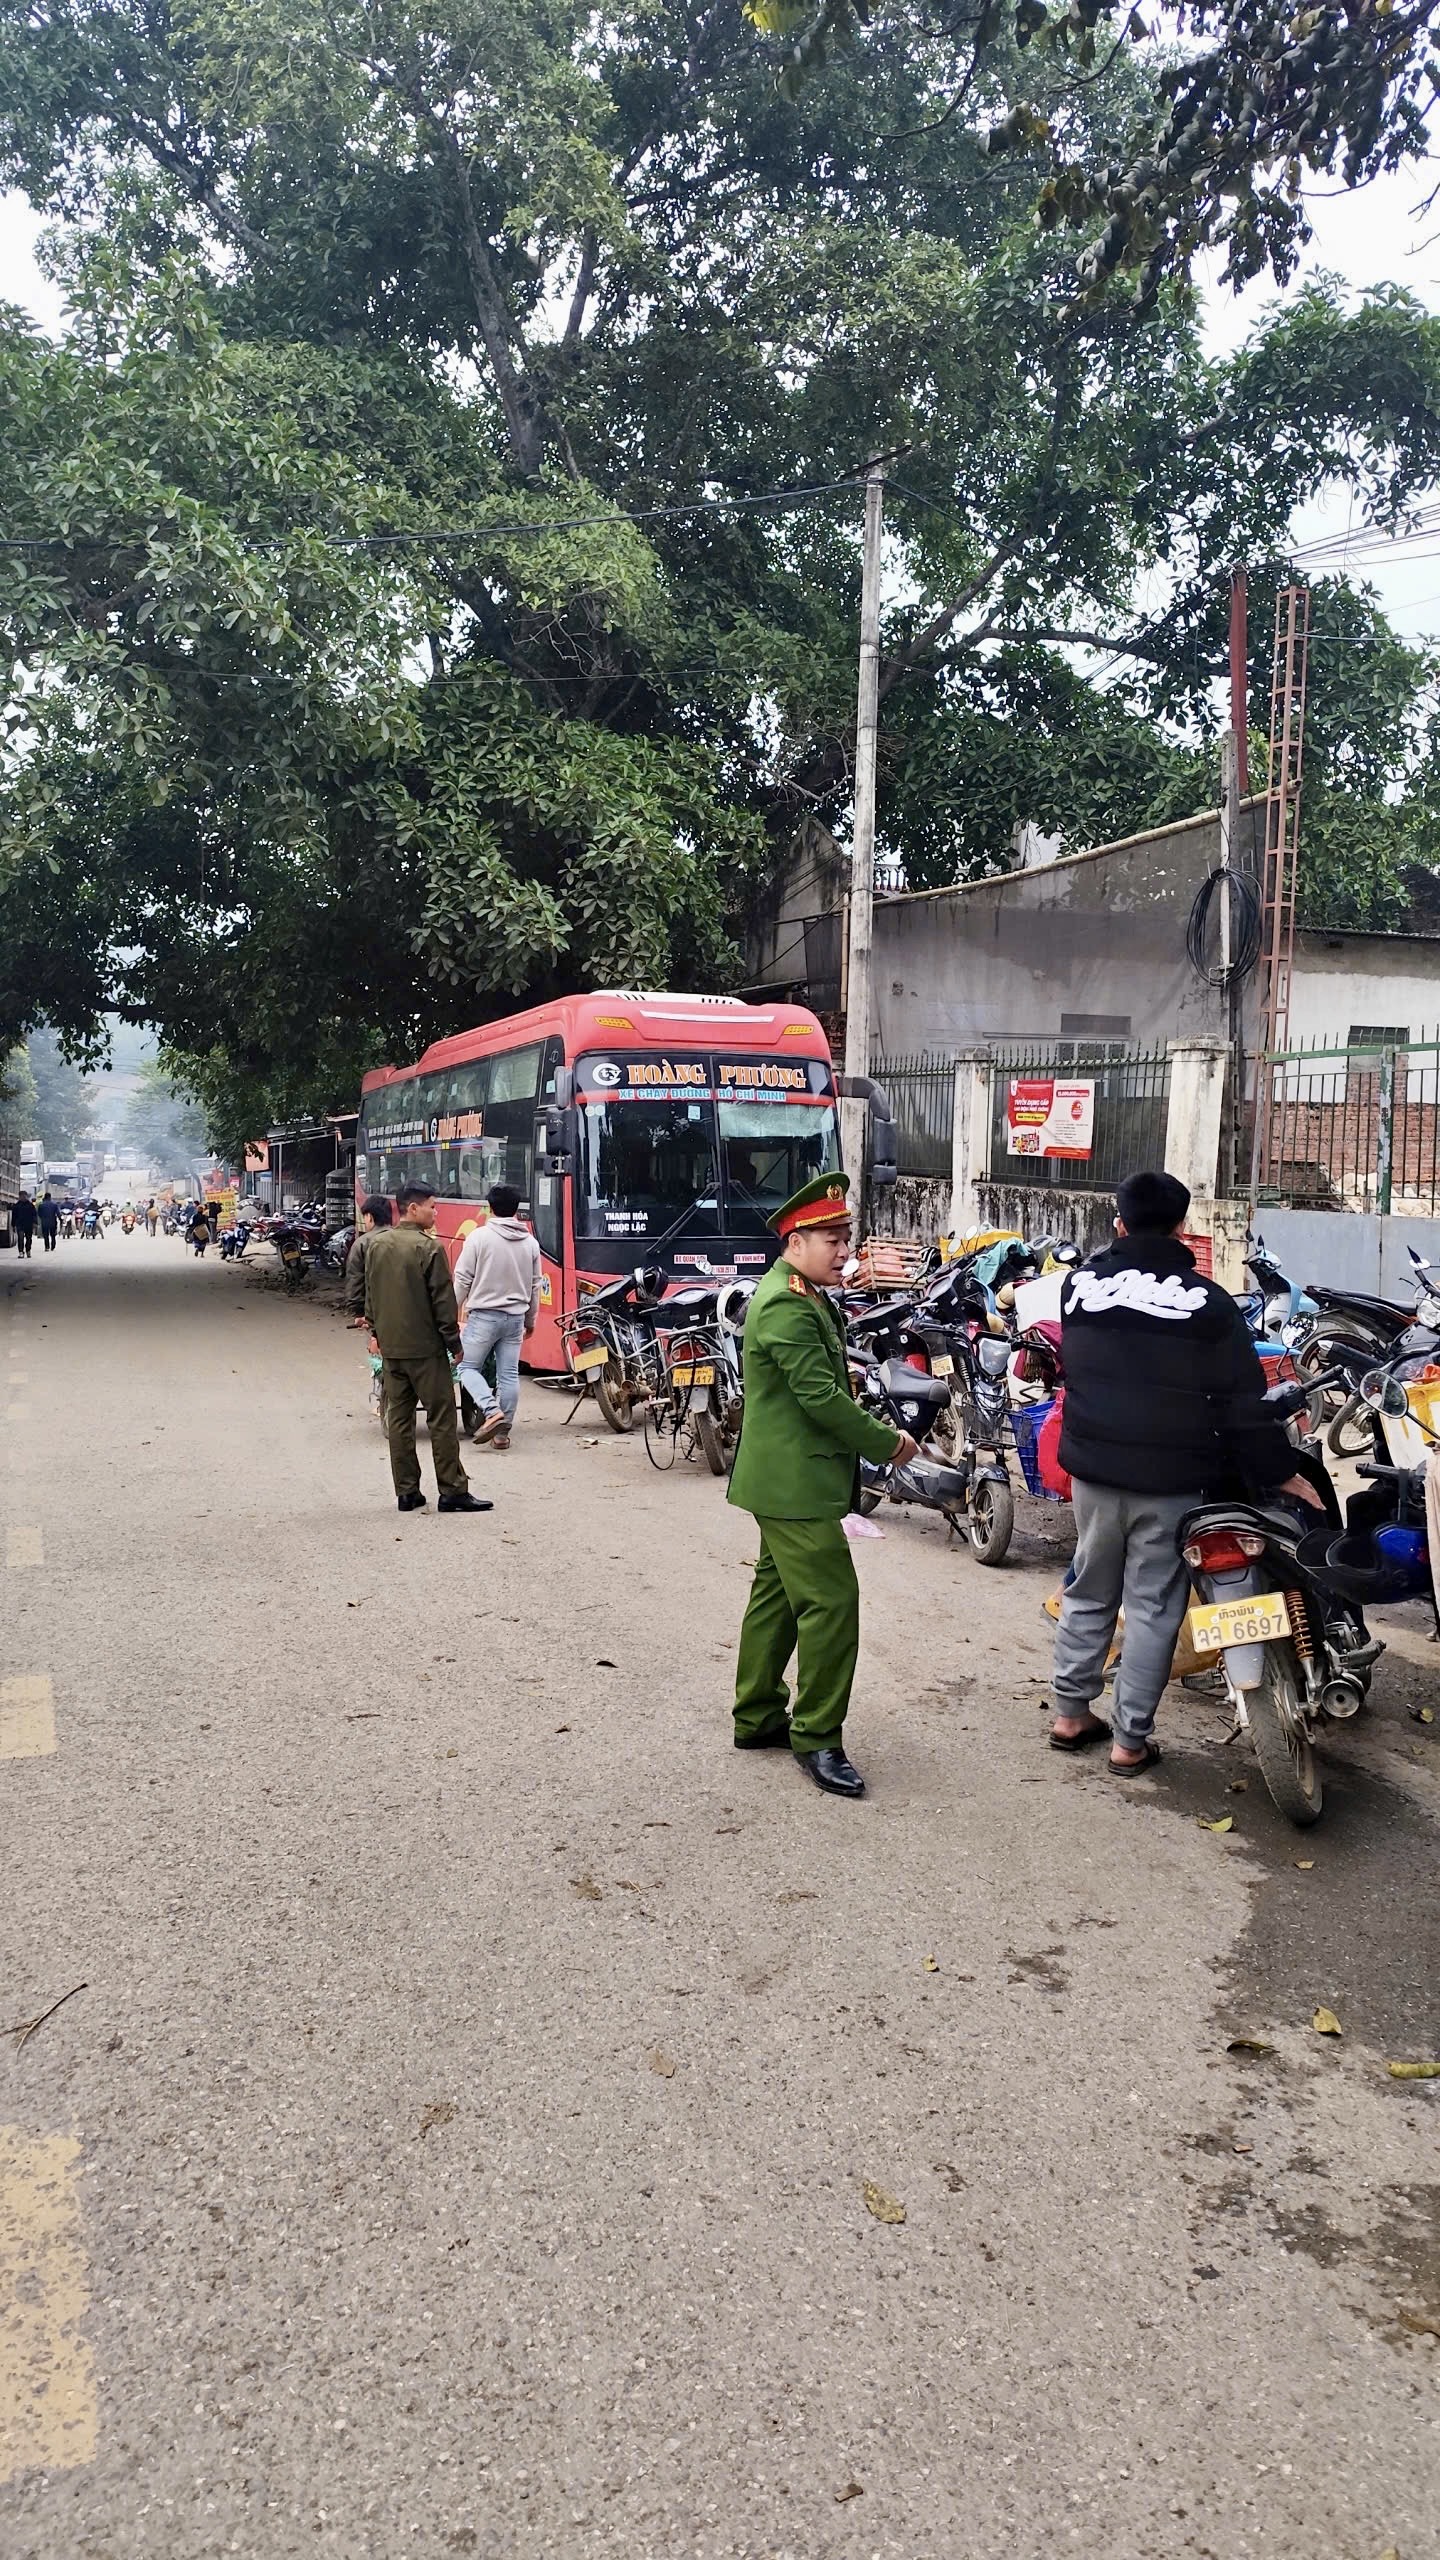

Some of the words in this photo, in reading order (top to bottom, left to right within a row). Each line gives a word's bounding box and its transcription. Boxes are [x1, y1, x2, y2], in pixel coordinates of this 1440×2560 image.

[627, 1059, 706, 1085] HOÀNG
[719, 1064, 806, 1088] PHƯƠNG
[619, 1089, 635, 1099] XE
[736, 1089, 754, 1100] CHÍ
[757, 1091, 786, 1101] MINH
[604, 1212, 631, 1221] THANH
[632, 1210, 648, 1221] HÓA
[608, 1223, 630, 1233] NGỌC
[1233, 1614, 1283, 1640] 6697
